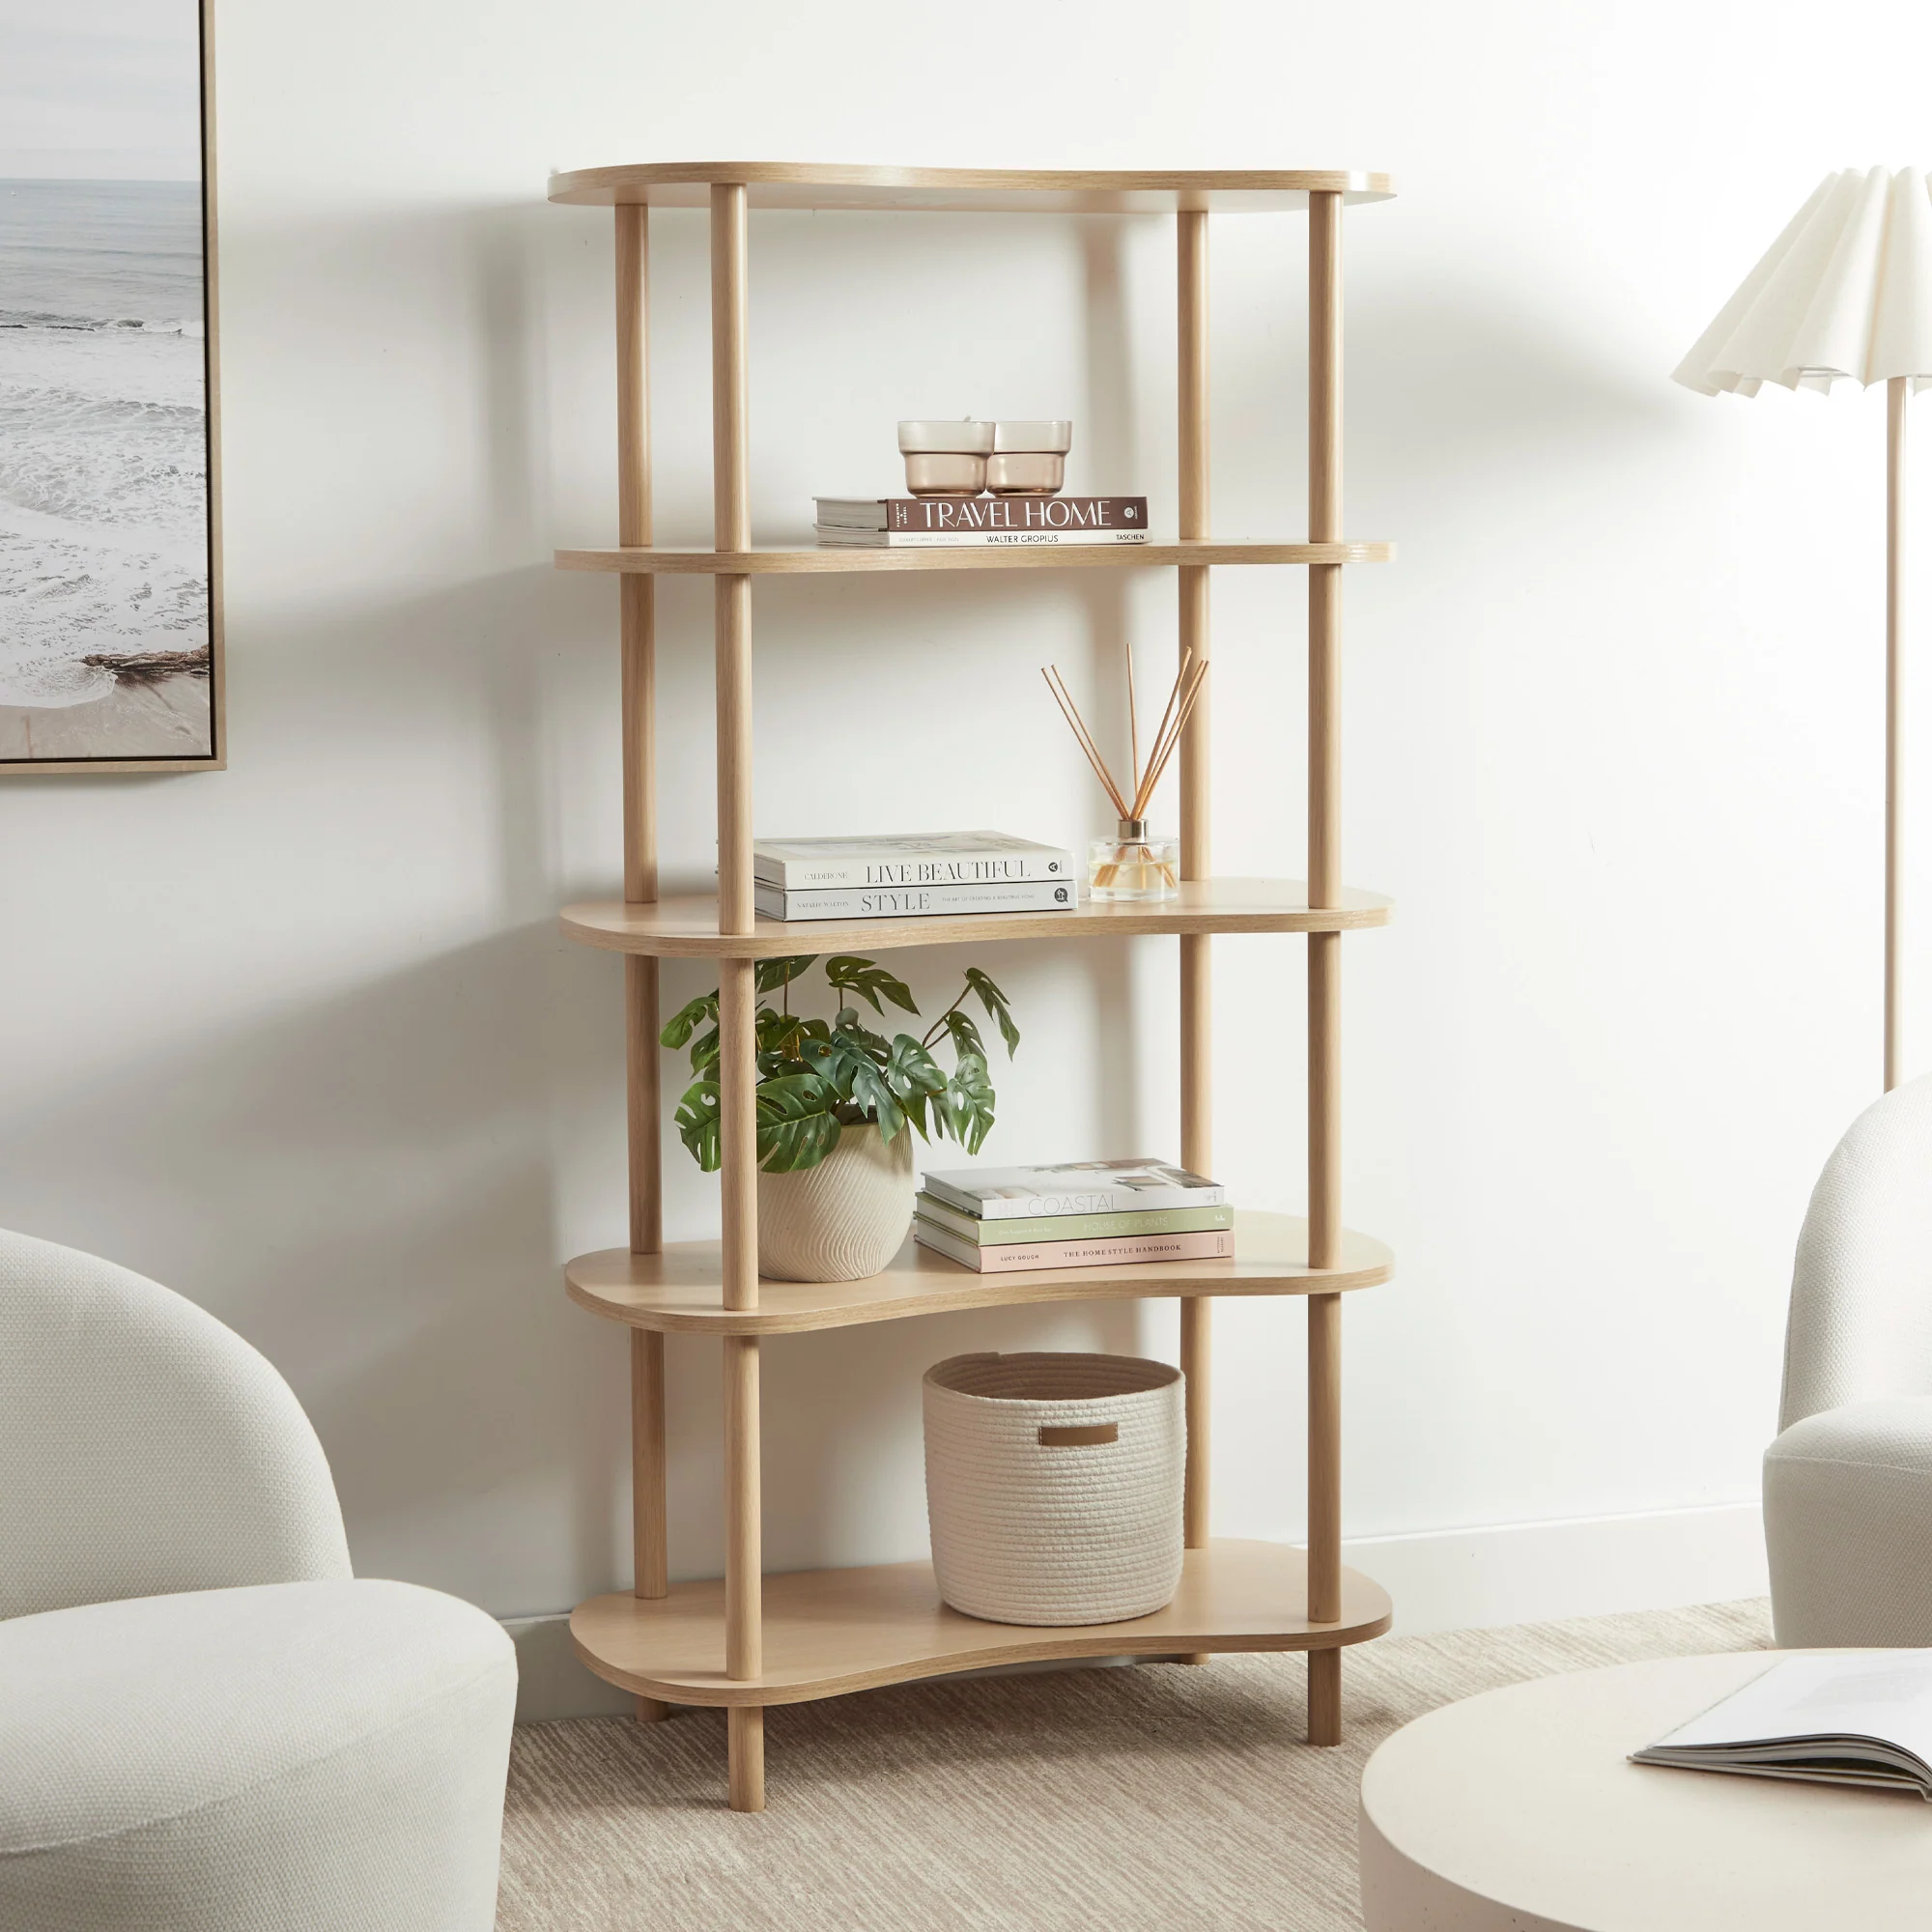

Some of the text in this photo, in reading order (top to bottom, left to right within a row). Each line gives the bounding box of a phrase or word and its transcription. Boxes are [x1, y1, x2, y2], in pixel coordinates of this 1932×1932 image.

[920, 502, 1018, 527] TRAVEL
[1025, 501, 1112, 527] HOME
[1021, 534, 1059, 543] GROPIUS
[804, 871, 848, 881] CALDERONE
[867, 860, 1031, 883] LIVE BEAUTIFUL
[861, 893, 930, 912] STYLE
[1029, 1194, 1121, 1215] COASTAL
[1084, 1217, 1168, 1232] HOUSE OF PLANTS
[1136, 1244, 1181, 1254] HANDBOOK
